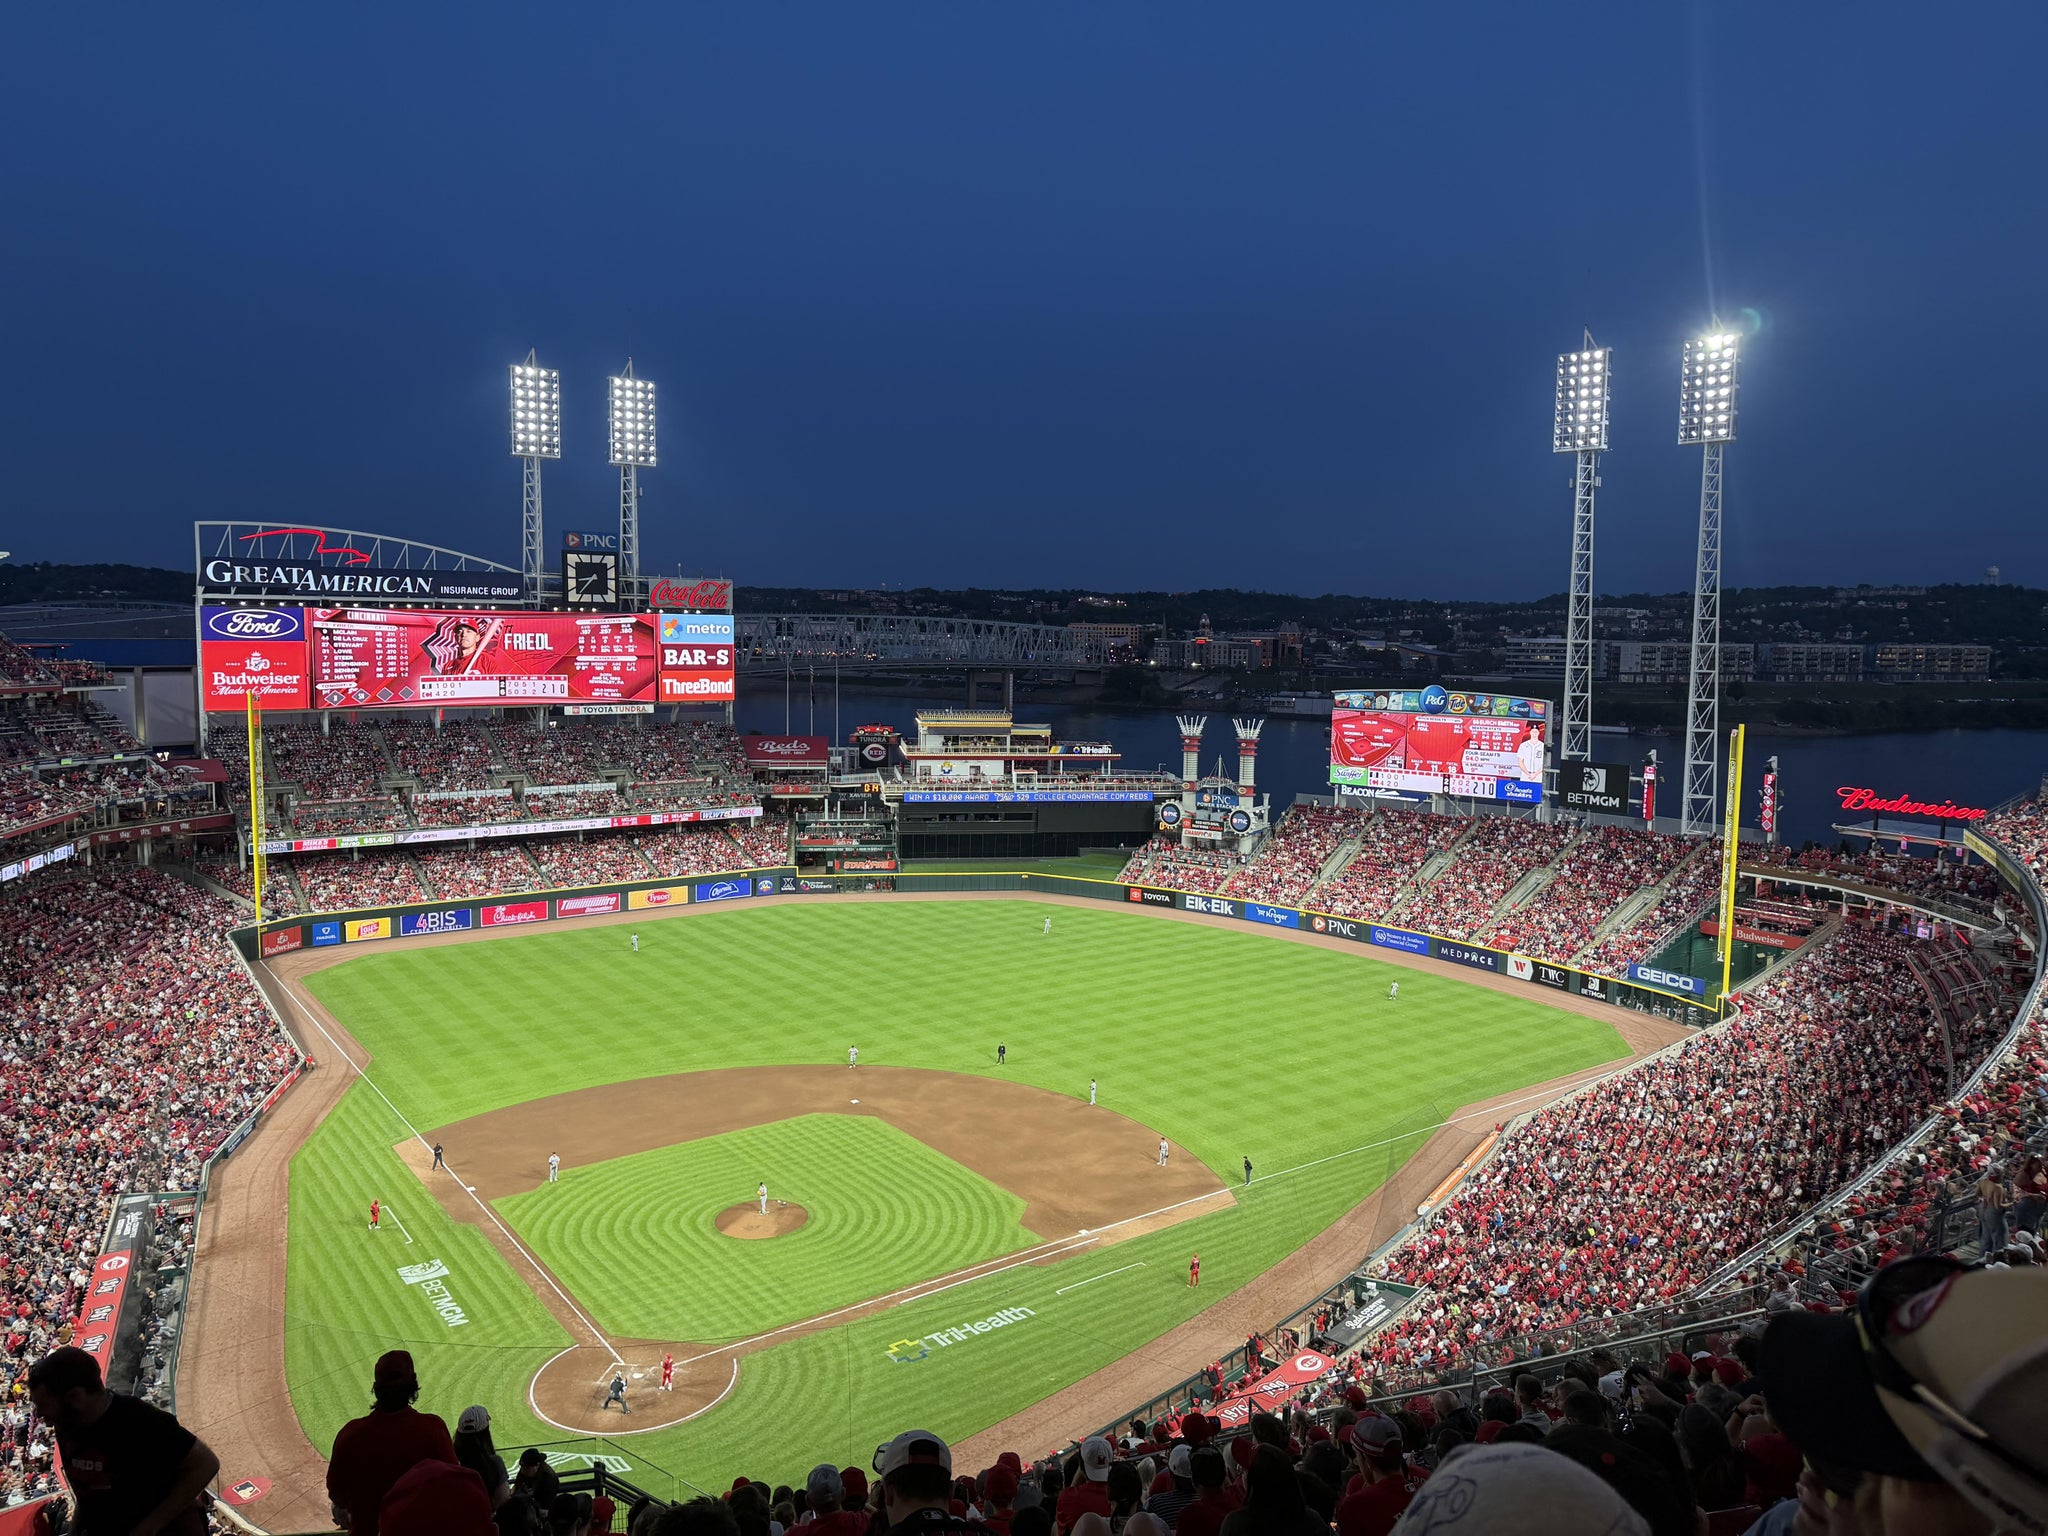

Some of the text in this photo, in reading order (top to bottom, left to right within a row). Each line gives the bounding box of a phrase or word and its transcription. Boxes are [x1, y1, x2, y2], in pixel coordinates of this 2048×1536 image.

[583, 535, 616, 548] PNC
[206, 560, 433, 594] GREAT AMERICAN
[440, 586, 519, 596] INSURANCE GROUP
[227, 613, 281, 633] Ford
[347, 611, 387, 622] CINCINNATI
[686, 622, 730, 634] metro
[504, 633, 554, 650] FRIEDL
[664, 650, 729, 665] BAR-S
[212, 672, 300, 685] Budweiser
[211, 686, 245, 695] Made
[257, 685, 298, 695] America
[662, 679, 733, 695] ThreeBond
[1425, 695, 1445, 706] P&G
[1450, 697, 1466, 709] Tide
[757, 740, 810, 754] Reds
[1081, 745, 1111, 754] TriHealth
[1334, 767, 1363, 781] Swiffer
[1341, 786, 1374, 798] BEACON
[1212, 795, 1230, 805] PNC
[1568, 792, 1620, 808] BETMGM
[1836, 786, 1987, 820] Budweiser
[648, 892, 670, 903] Tyson
[1144, 892, 1170, 902] TOYOTA
[585, 905, 612, 913] Discounters
[1266, 908, 1288, 923] Kroger
[416, 910, 456, 928] 4BIS
[358, 921, 379, 936] Lay's
[433, 924, 463, 932] SECURITY
[1328, 921, 1356, 937] PNC
[1407, 936, 1425, 945] Southern
[1736, 929, 1785, 946] Budweiser
[264, 941, 300, 955] Budweiser
[1405, 941, 1418, 949] Group
[1441, 947, 1493, 965] MEDPACE
[1514, 960, 1526, 972] W
[1539, 966, 1565, 983] TWC
[1637, 966, 1694, 991] GEICO
[1581, 988, 1606, 999] BETMGM
[421, 1279, 469, 1327] BETMGM
[924, 1306, 1036, 1347] TriHealth
[1345, 1314, 1365, 1329] Reds
[1260, 1380, 1286, 1395] 1990
[1220, 1404, 1249, 1421] 1976
